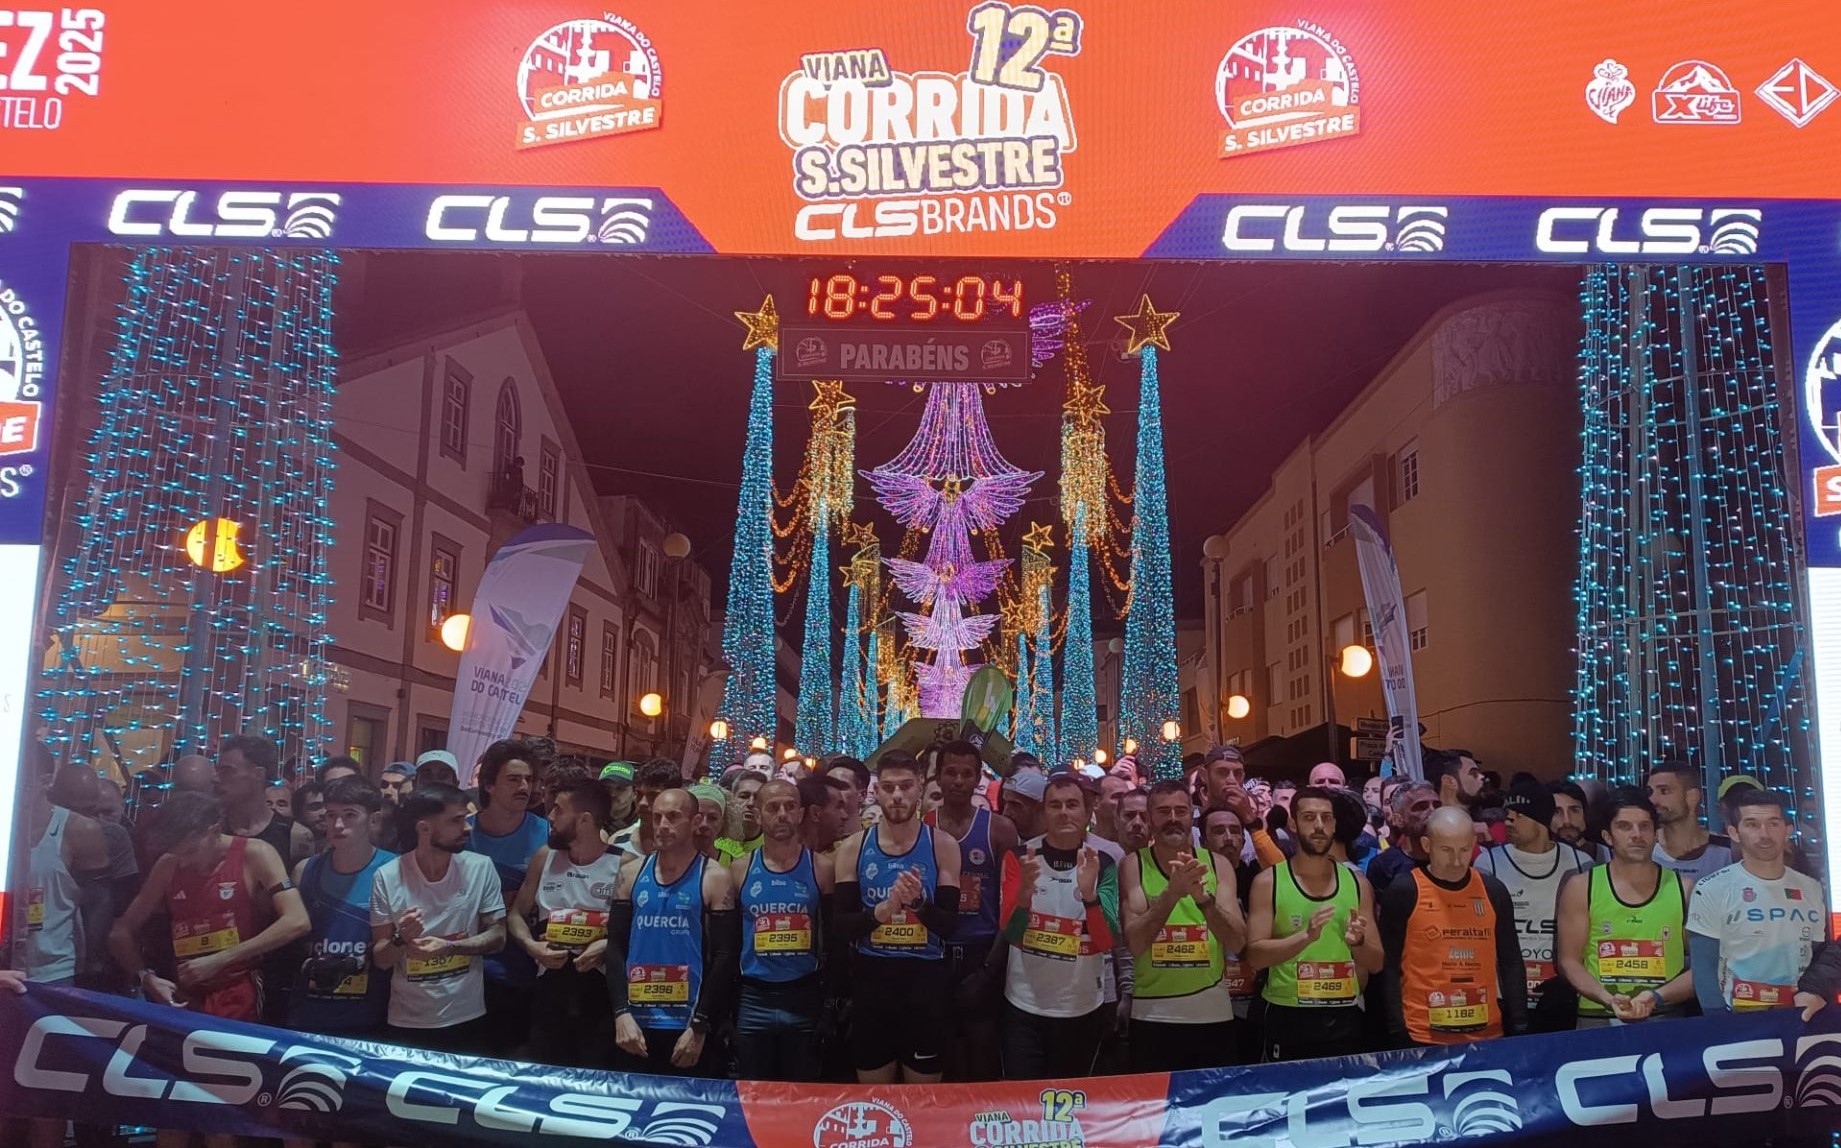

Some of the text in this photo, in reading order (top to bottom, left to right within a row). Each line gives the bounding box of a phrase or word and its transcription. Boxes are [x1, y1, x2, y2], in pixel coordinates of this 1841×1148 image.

[54, 7, 106, 96] 2025
[603, 10, 663, 97] VIANA DO CASTELO
[1297, 18, 1360, 104] VIANA DO CASTELO
[805, 52, 887, 82] VIANA
[540, 79, 628, 109] CORRIDA
[1240, 88, 1326, 117] CORRIDA
[523, 106, 656, 145] S. SILVESTRE
[785, 76, 1072, 147] CORRIDA
[1224, 113, 1355, 152] S. SILVESTRE
[808, 274, 1022, 320] 18:25:04
[21, 315, 39, 396] CASTELO
[840, 337, 970, 371] PARABÉNS
[637, 914, 691, 930] QUERCIA
[749, 903, 809, 917] QUERCIA
[562, 926, 593, 938] 2393
[885, 927, 914, 937] 2400
[1036, 933, 1066, 946] 2387
[1166, 944, 1195, 954] 2462
[1615, 960, 1649, 969] 2458
[1313, 982, 1342, 991] 2469
[1446, 1009, 1475, 1018] 1182
[970, 1118, 1086, 1145] CORRIDA
[975, 1112, 1009, 1123] VIANA
